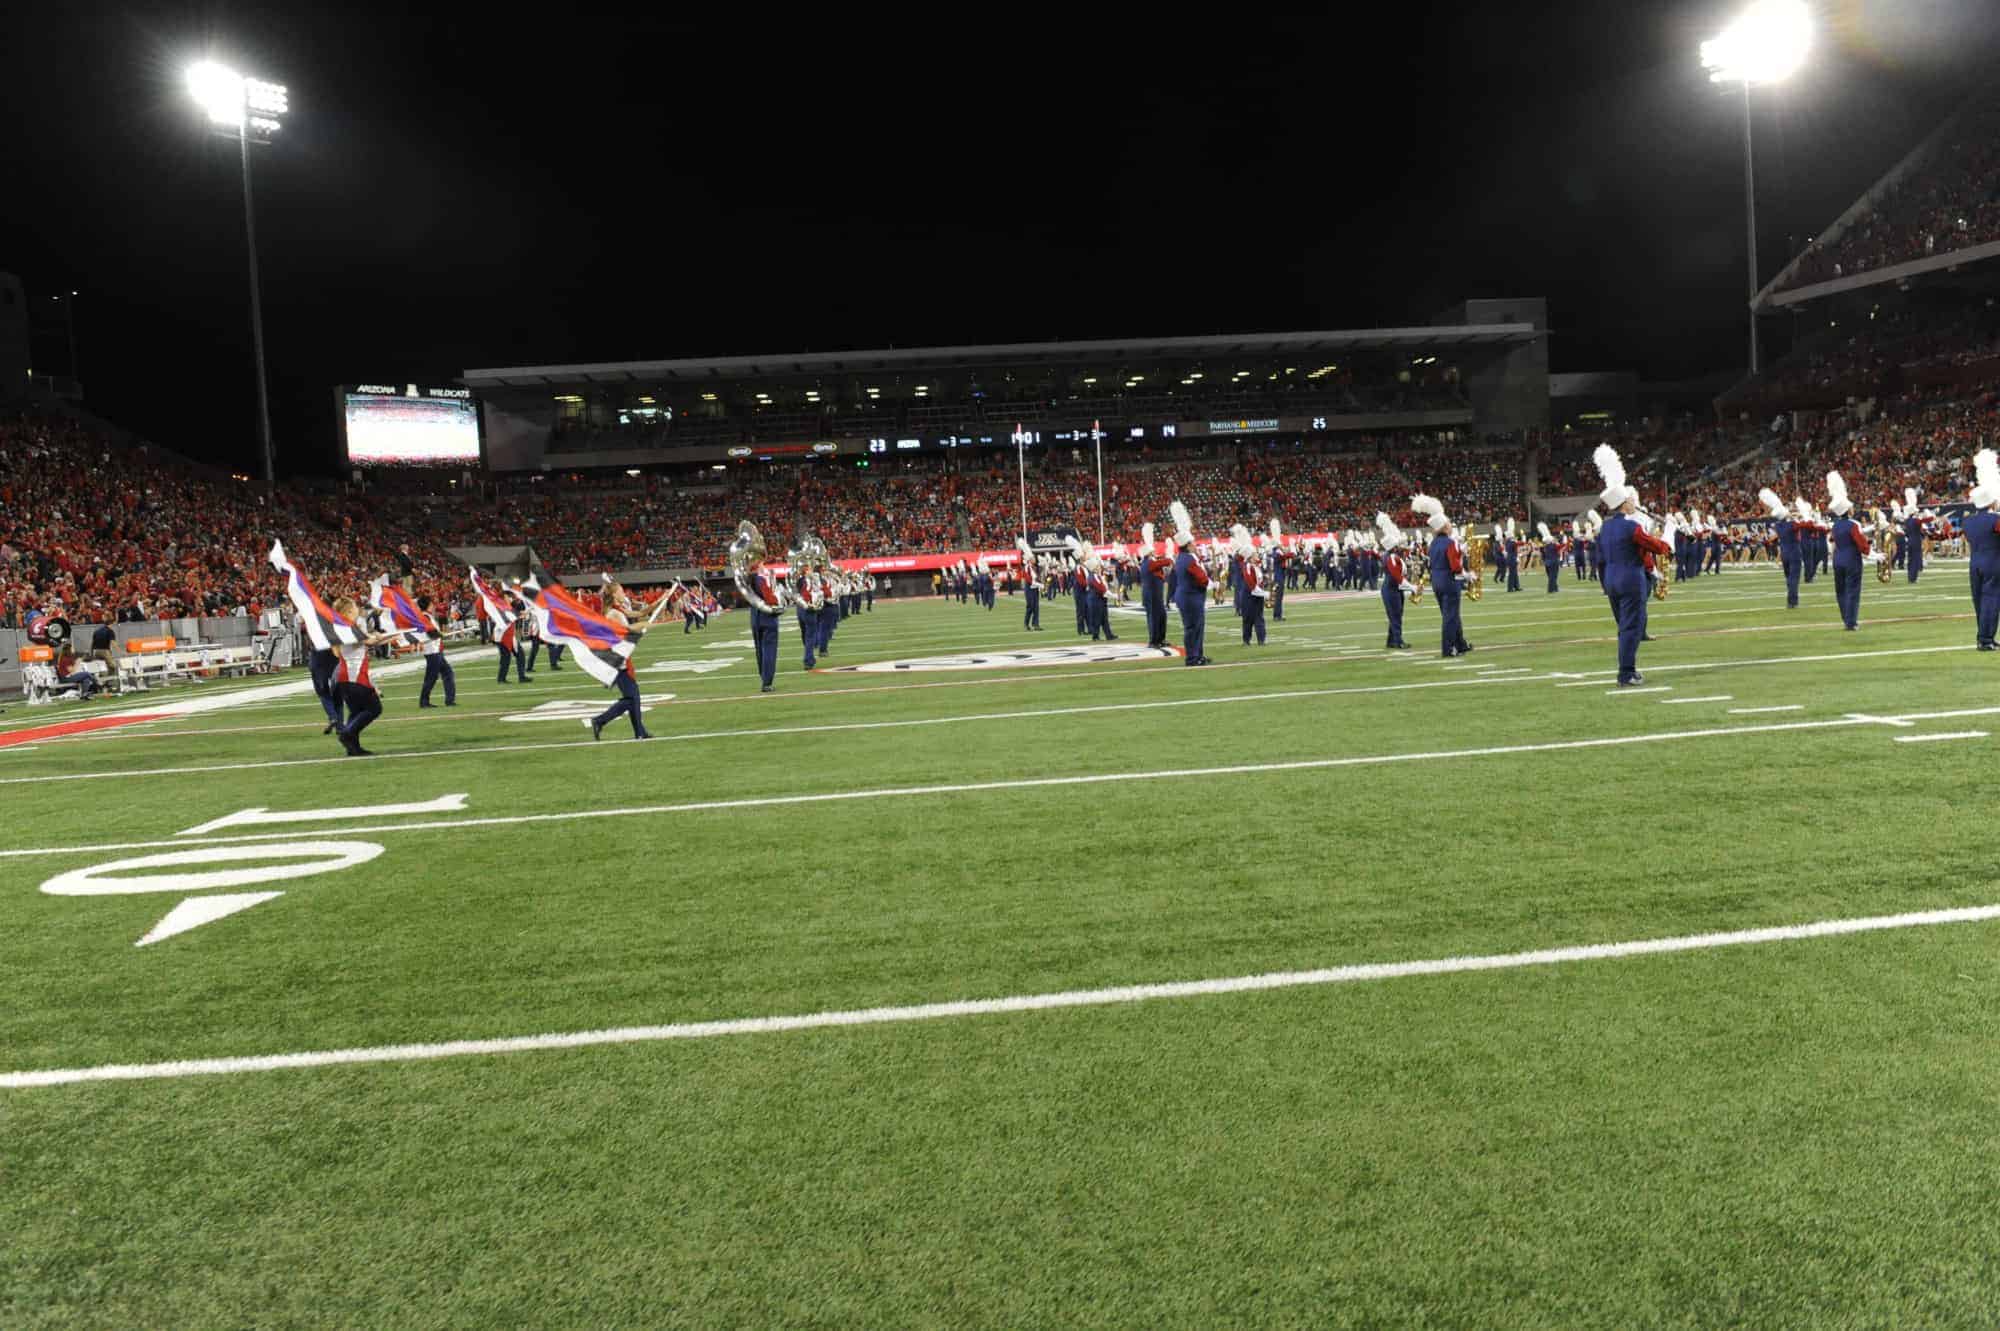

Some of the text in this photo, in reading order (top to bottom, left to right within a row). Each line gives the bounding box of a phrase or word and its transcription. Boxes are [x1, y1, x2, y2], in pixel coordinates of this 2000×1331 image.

[357, 384, 396, 394] ARIZONA
[429, 388, 470, 398] WILDCATS
[1312, 417, 1327, 429] 25
[1163, 425, 1176, 437] 14
[39, 793, 469, 896] 10
